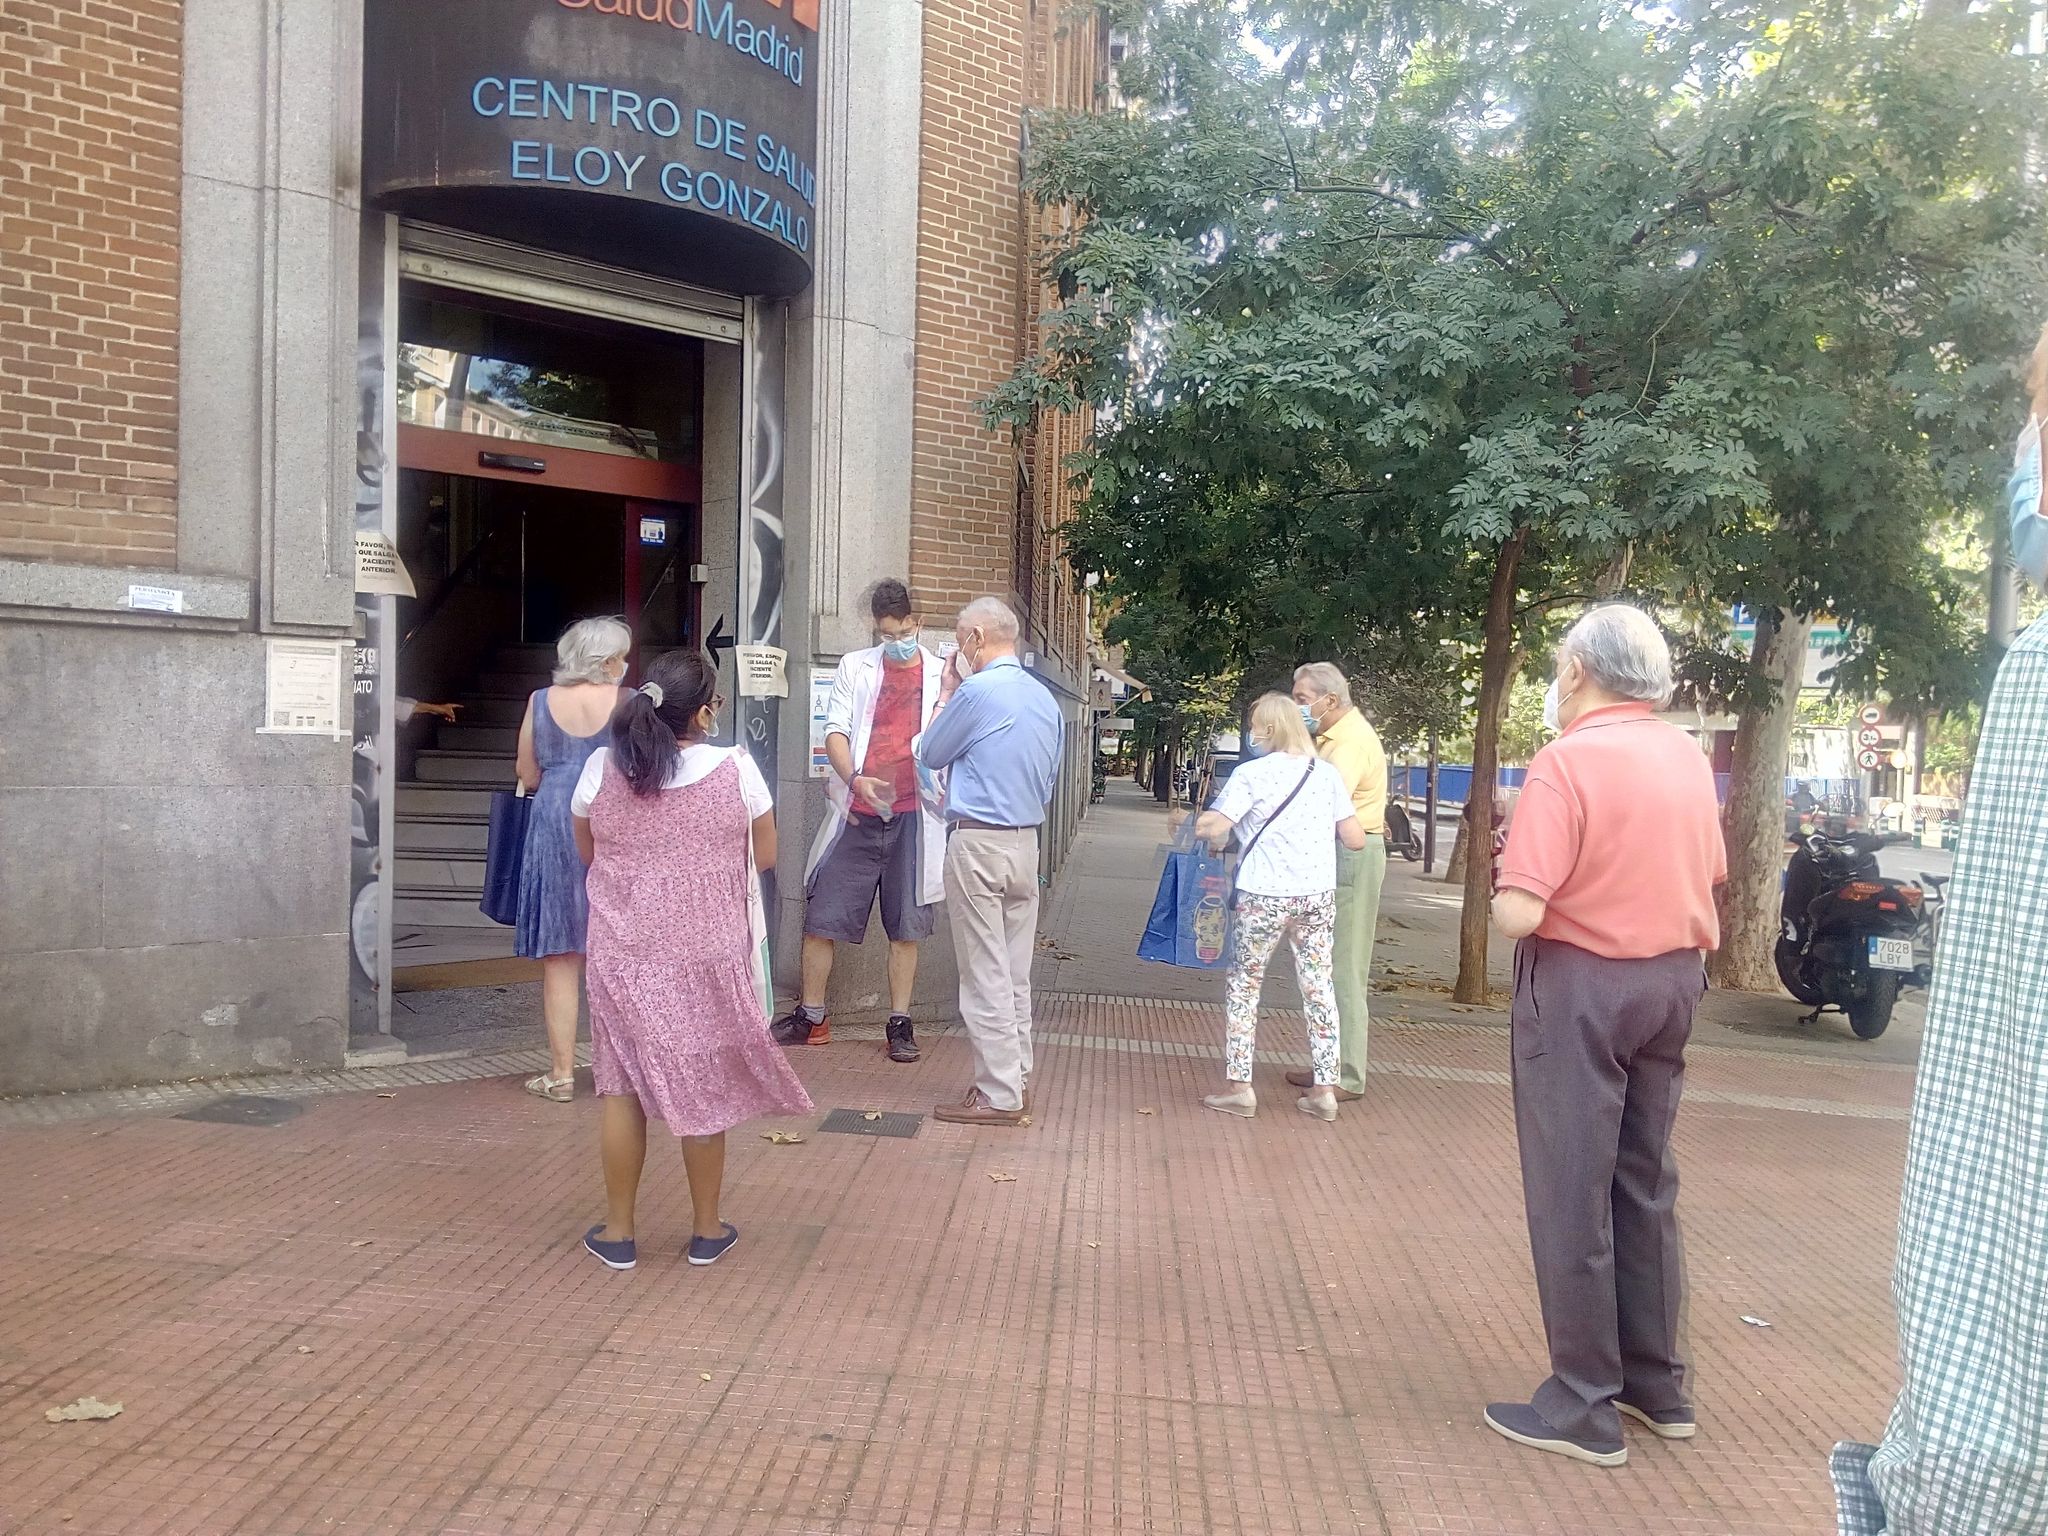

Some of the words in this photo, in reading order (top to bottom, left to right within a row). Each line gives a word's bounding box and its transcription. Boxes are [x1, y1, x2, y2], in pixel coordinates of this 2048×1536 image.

[556, 0, 804, 88] audMadrid
[472, 76, 681, 138] CENTRO
[695, 108, 746, 161] DE
[756, 133, 815, 209] SALUD
[511, 140, 646, 191] ELOY
[660, 161, 809, 253] GONZALO
[361, 541, 386, 550] FAVOR,
[1880, 940, 1910, 955] 7028
[1880, 952, 1901, 965] LBY
